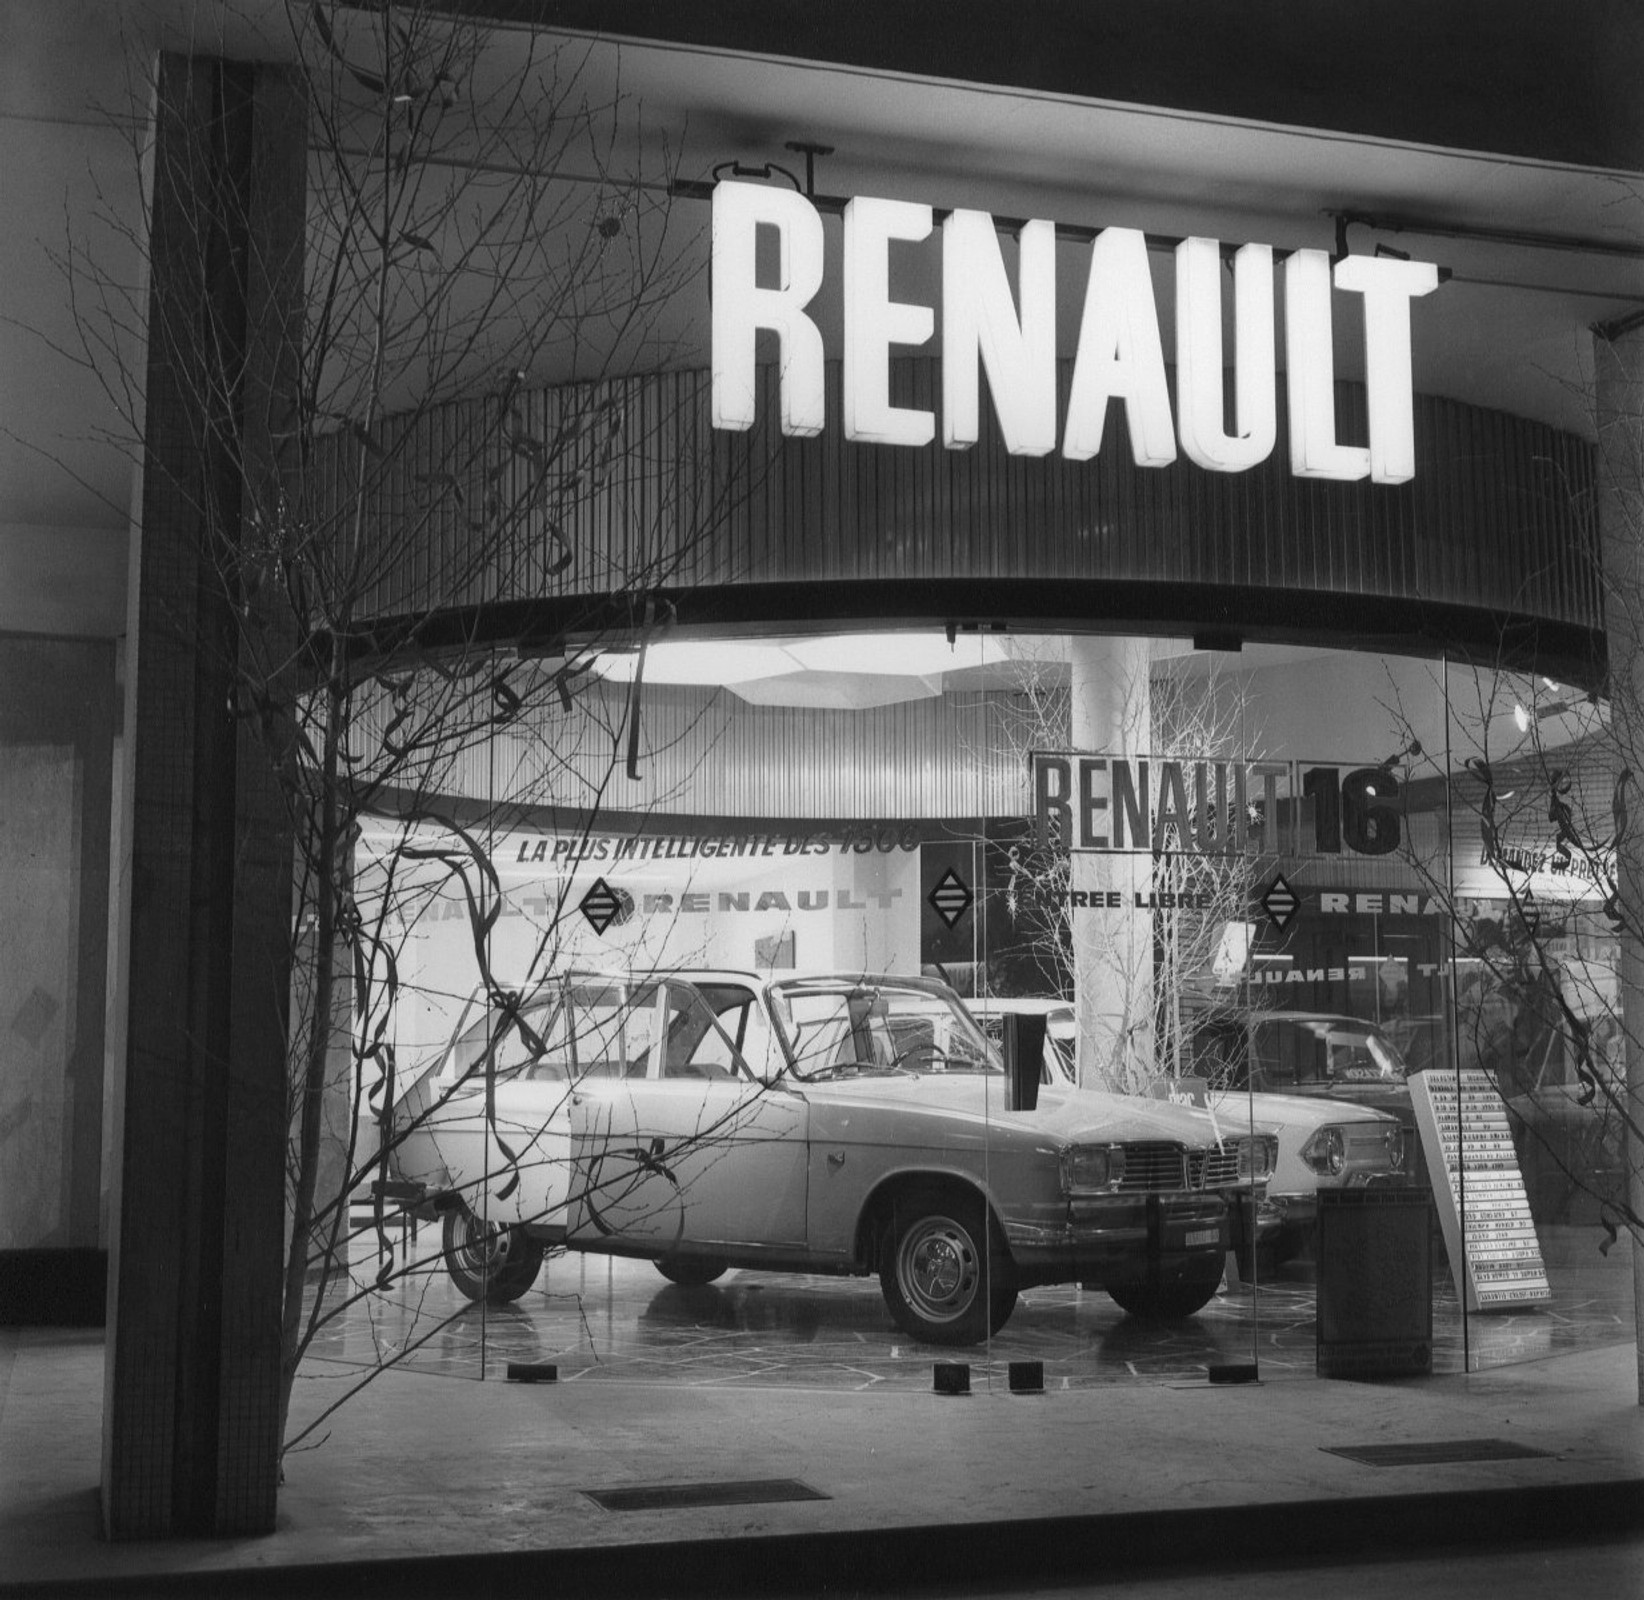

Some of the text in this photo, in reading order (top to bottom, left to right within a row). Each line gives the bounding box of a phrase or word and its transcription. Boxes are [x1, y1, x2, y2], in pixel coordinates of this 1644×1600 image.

[711, 180, 1439, 486] RENAULT
[1035, 757, 1401, 855] RENAULT 16
[516, 840, 548, 863] LA
[550, 838, 611, 862] PLUS
[612, 834, 780, 861] INTELLIGENTE
[782, 832, 832, 855] DES
[375, 897, 555, 925] RENALT
[643, 888, 902, 913] RENAULT
[1134, 892, 1213, 909] LIBRE
